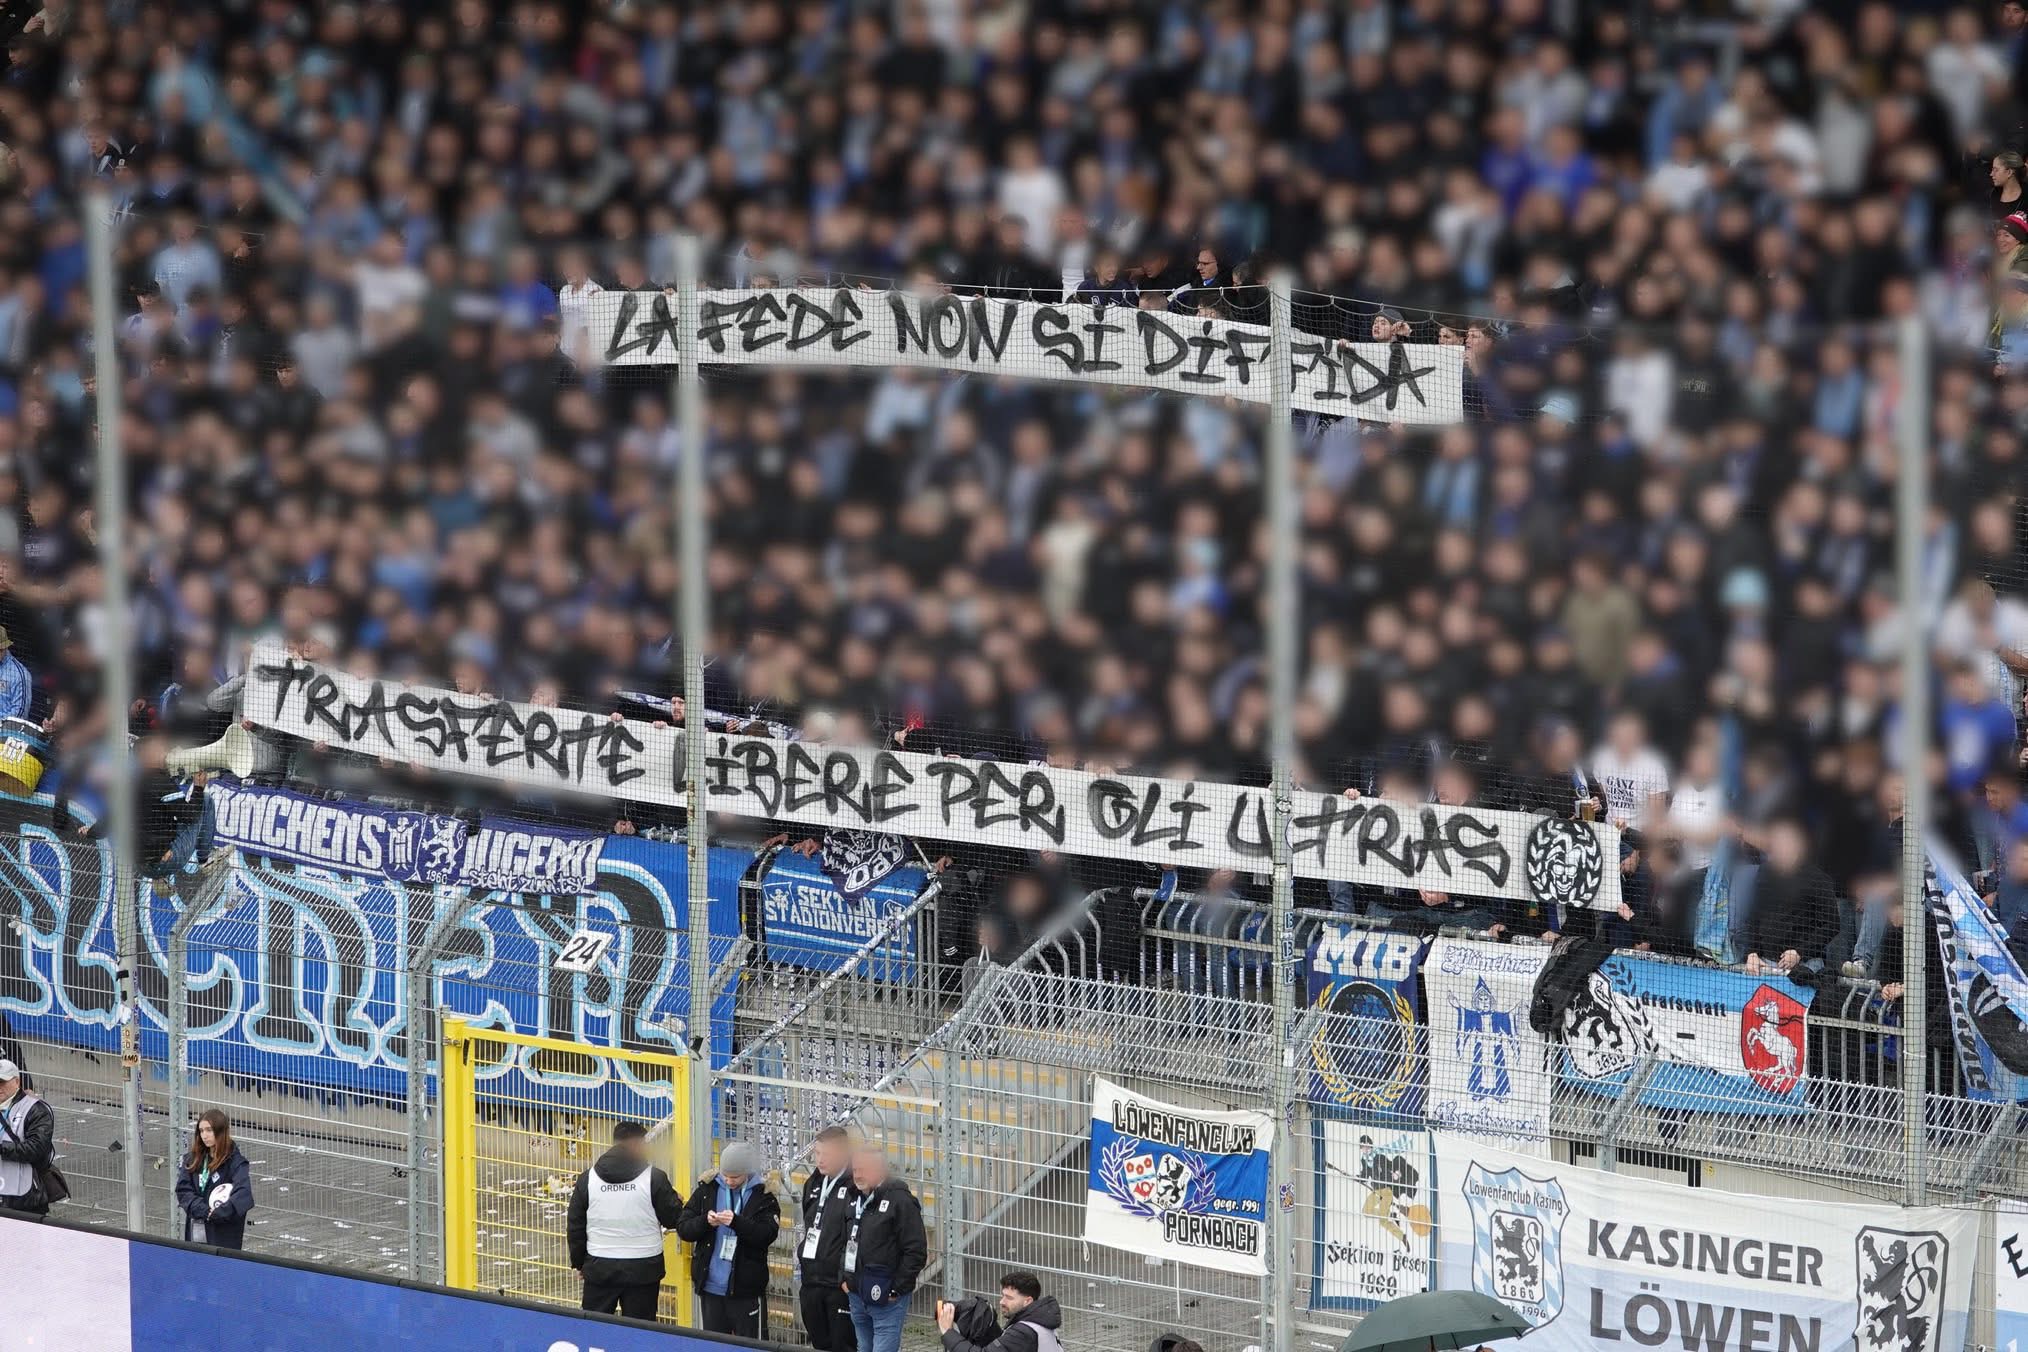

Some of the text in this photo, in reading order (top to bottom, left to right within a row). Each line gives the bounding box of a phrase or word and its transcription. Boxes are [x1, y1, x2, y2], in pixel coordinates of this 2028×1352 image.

[604, 292, 679, 361] LA
[697, 293, 871, 352] FEDE
[888, 291, 1017, 362] NON
[1032, 304, 1125, 372] SI
[253, 657, 645, 786] TRASFERTE
[926, 761, 1065, 844] PER
[1088, 780, 1210, 850] GLI
[426, 869, 448, 885] 1860
[562, 936, 602, 964] 24
[1641, 991, 1726, 1017] Grafschaft
[600, 1184, 637, 1193] ORDNER
[1469, 1180, 1563, 1216] Löwenfanclub Kasing
[1164, 1208, 1260, 1256] PÖRNBACH
[1327, 1240, 1384, 1266] Sektion
[1588, 1218, 1824, 1287] KASINGER
[1502, 1284, 1535, 1300] 1860
[1522, 1305, 1546, 1319] 1996
[1590, 1282, 1822, 1352] LÖWEN
